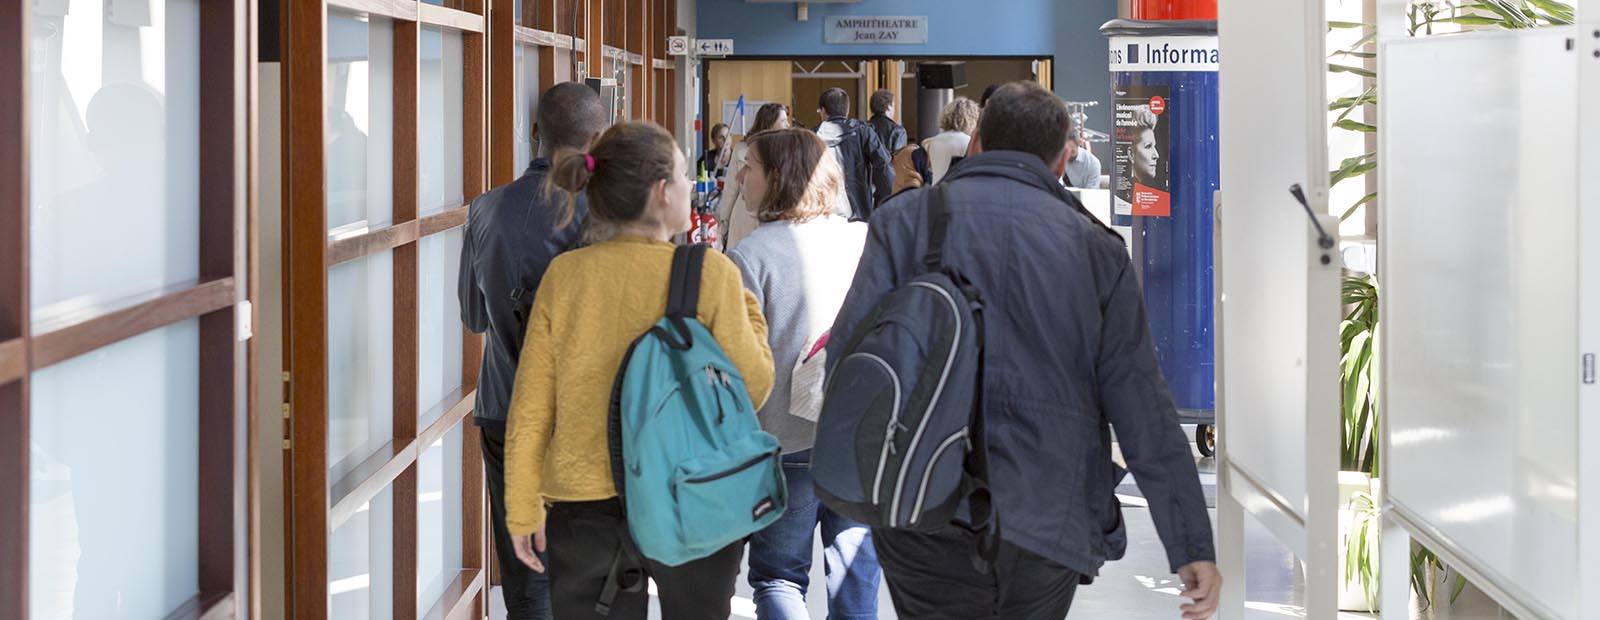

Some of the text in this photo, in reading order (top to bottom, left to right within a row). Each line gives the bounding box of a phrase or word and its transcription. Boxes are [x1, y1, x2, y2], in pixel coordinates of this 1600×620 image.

[836, 19, 920, 28] AMPHITHEATRE
[854, 31, 898, 41] Jean ZAY
[1146, 43, 1219, 64] Informa
